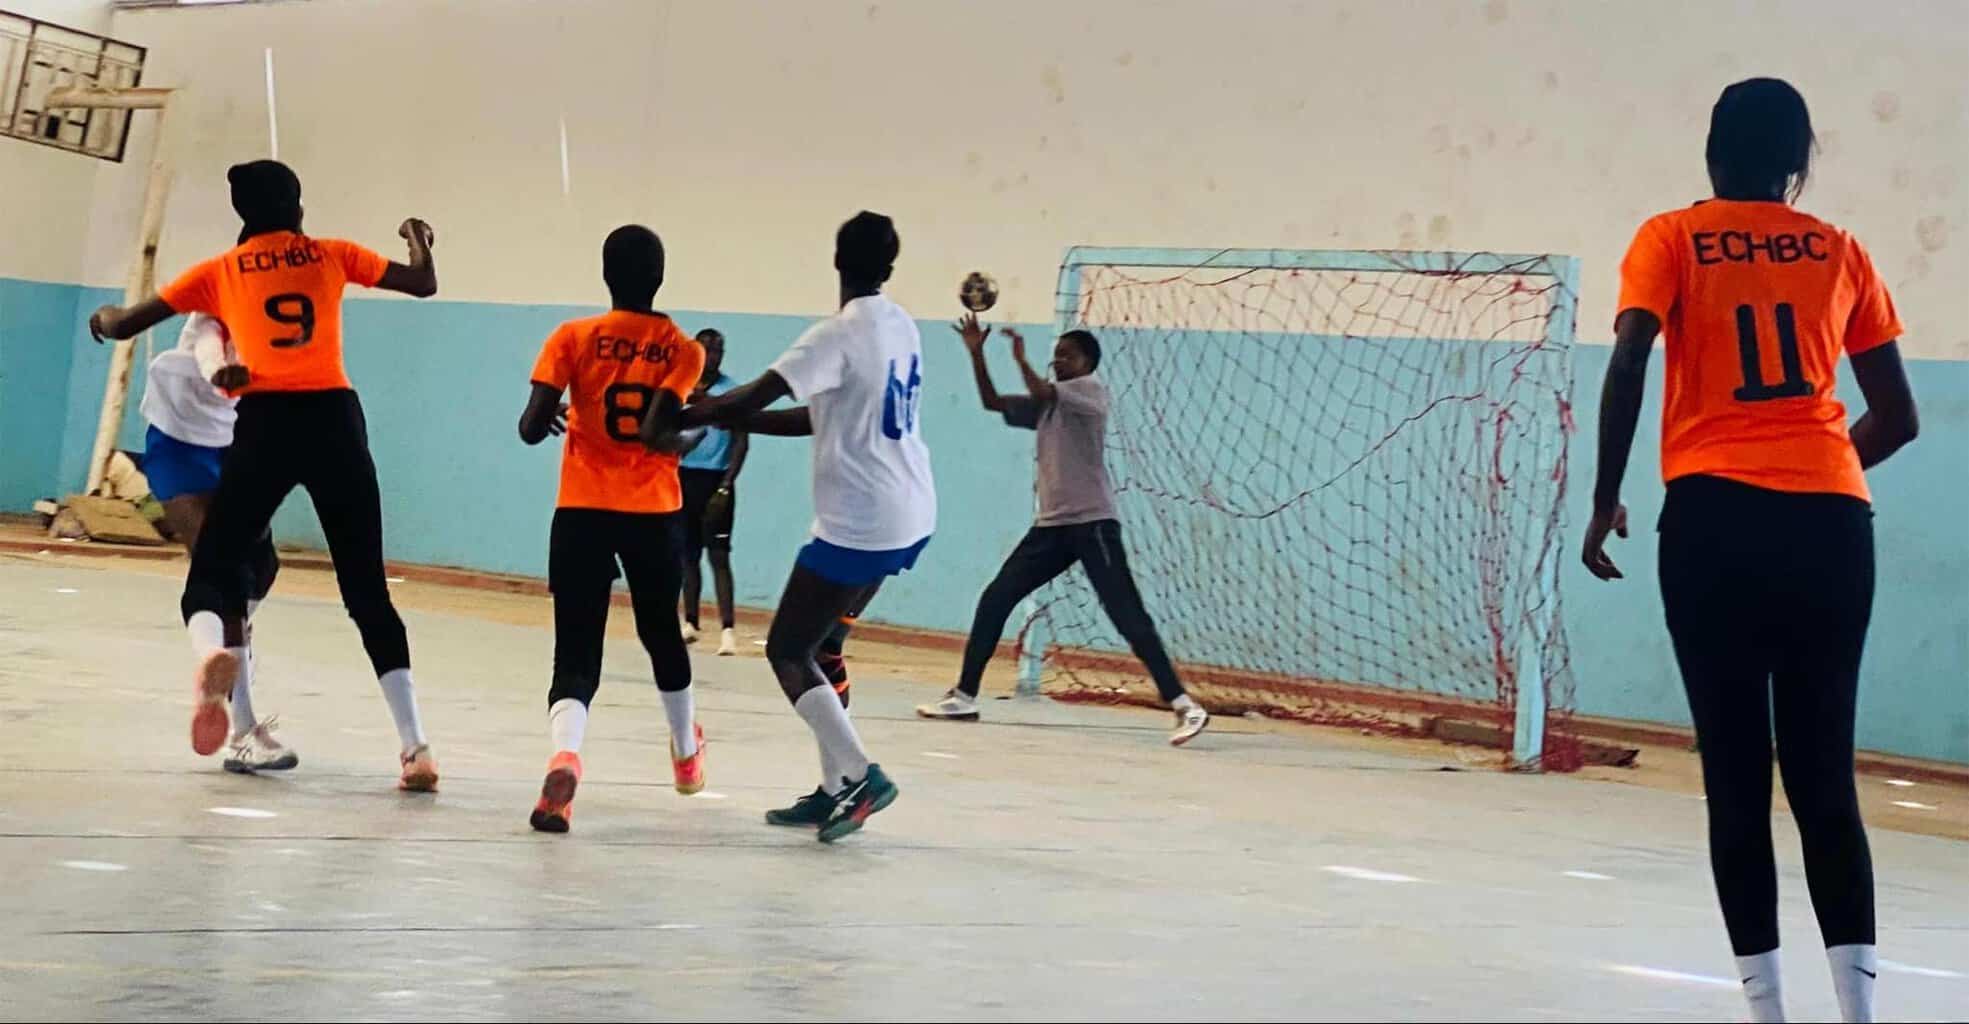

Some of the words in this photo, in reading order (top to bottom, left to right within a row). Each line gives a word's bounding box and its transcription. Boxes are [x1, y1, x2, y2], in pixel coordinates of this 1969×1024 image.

[1692, 230, 1829, 265] ECHBC
[264, 293, 316, 349] 9
[1733, 302, 1815, 401] 11
[604, 383, 656, 442] 8
